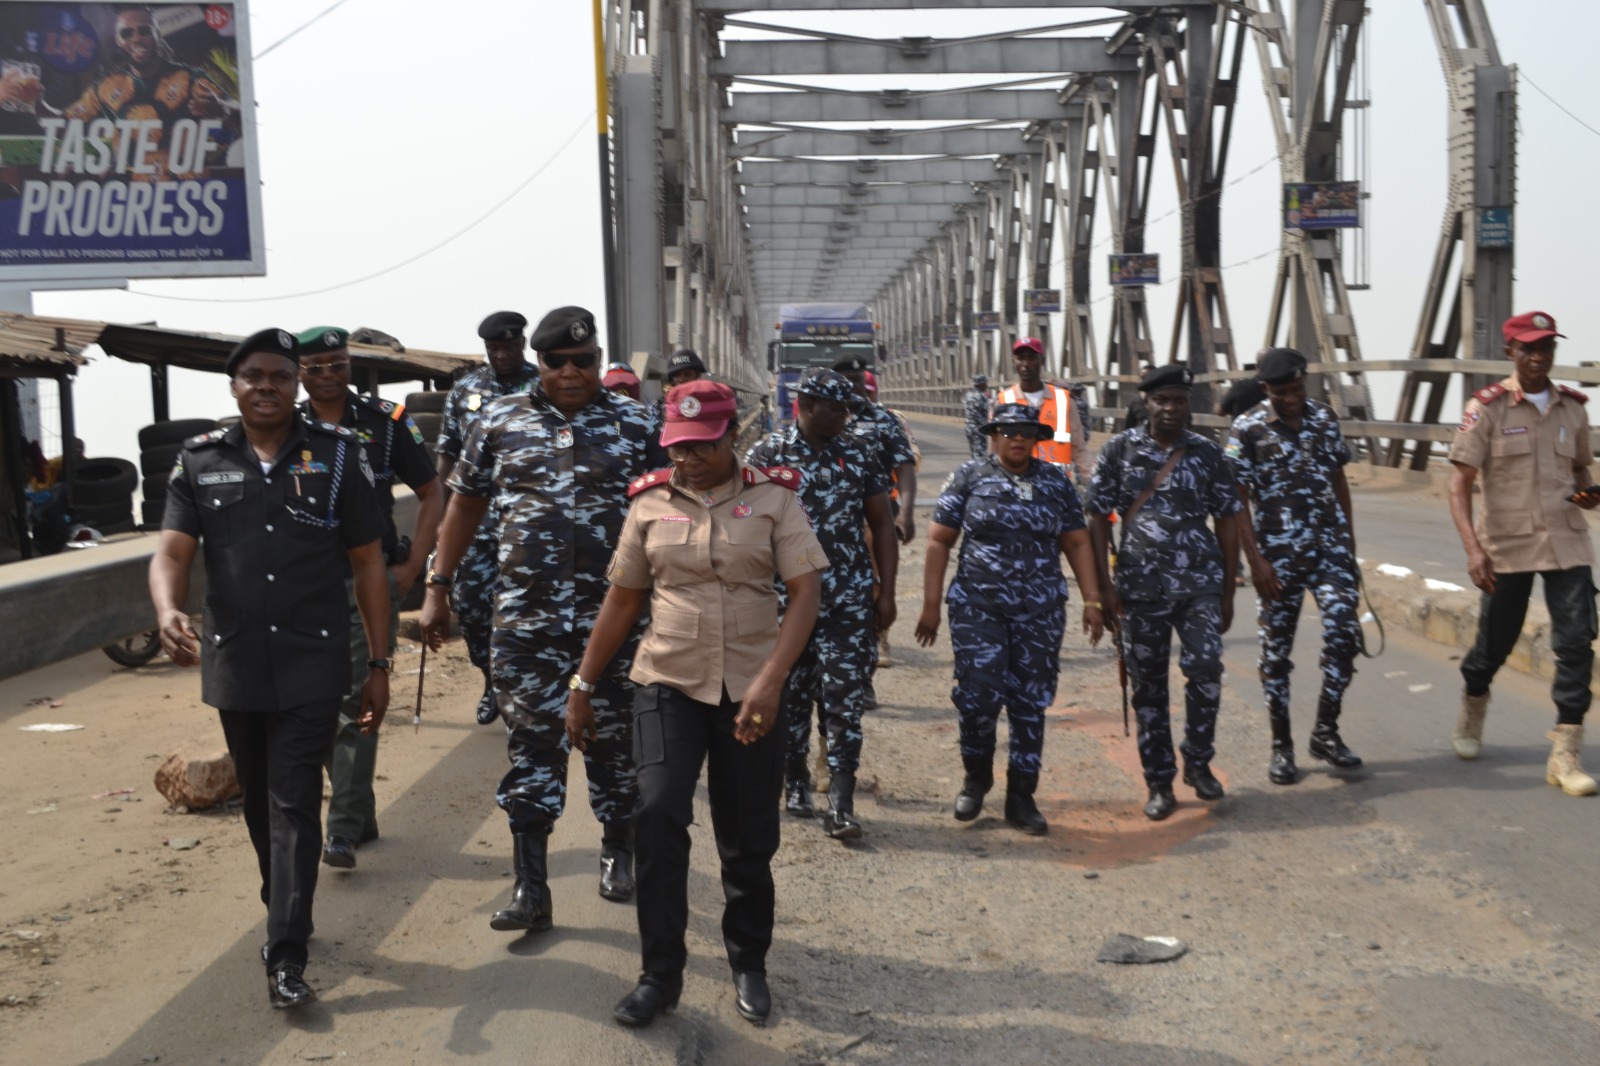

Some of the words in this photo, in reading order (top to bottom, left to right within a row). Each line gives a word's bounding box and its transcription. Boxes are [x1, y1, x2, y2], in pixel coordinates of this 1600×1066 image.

[40, 117, 163, 174] TASTE
[168, 118, 223, 174] OF
[18, 180, 227, 236] PROGRESS
[20, 248, 41, 258] FOR
[41, 248, 66, 258] SALE
[66, 248, 82, 258] TO
[82, 248, 125, 258] PERSONS
[126, 248, 158, 258] UNDER
[159, 248, 177, 258] THE
[178, 248, 197, 258] AGE
[197, 248, 211, 257] OF
[672, 355, 690, 364] POLICE
